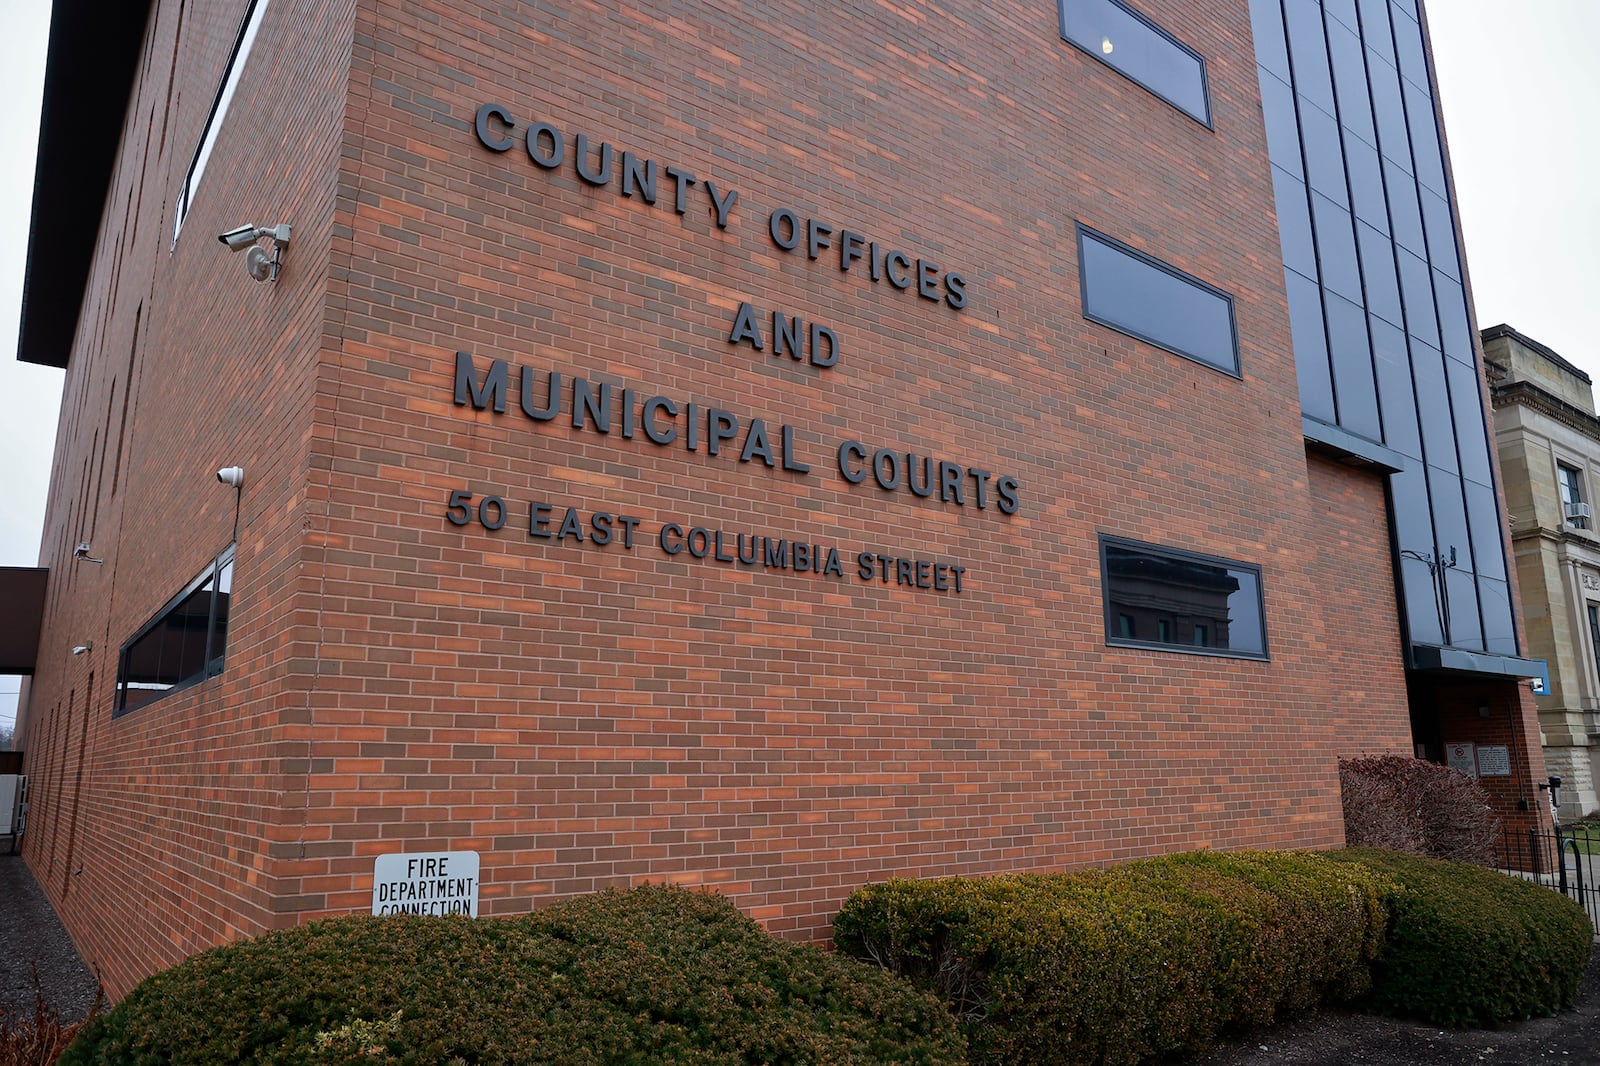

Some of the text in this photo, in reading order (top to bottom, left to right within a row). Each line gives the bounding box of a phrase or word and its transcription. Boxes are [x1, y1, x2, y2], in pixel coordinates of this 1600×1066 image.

[475, 103, 968, 310] COUNTY OFFICES
[729, 302, 840, 368] AND
[454, 352, 1019, 514] MUNICIPAL COURTS
[446, 490, 966, 592] 50 EAST COLUMBIA STREET
[380, 878, 473, 902] DEPARTMENT
[408, 858, 448, 878] FIRE
